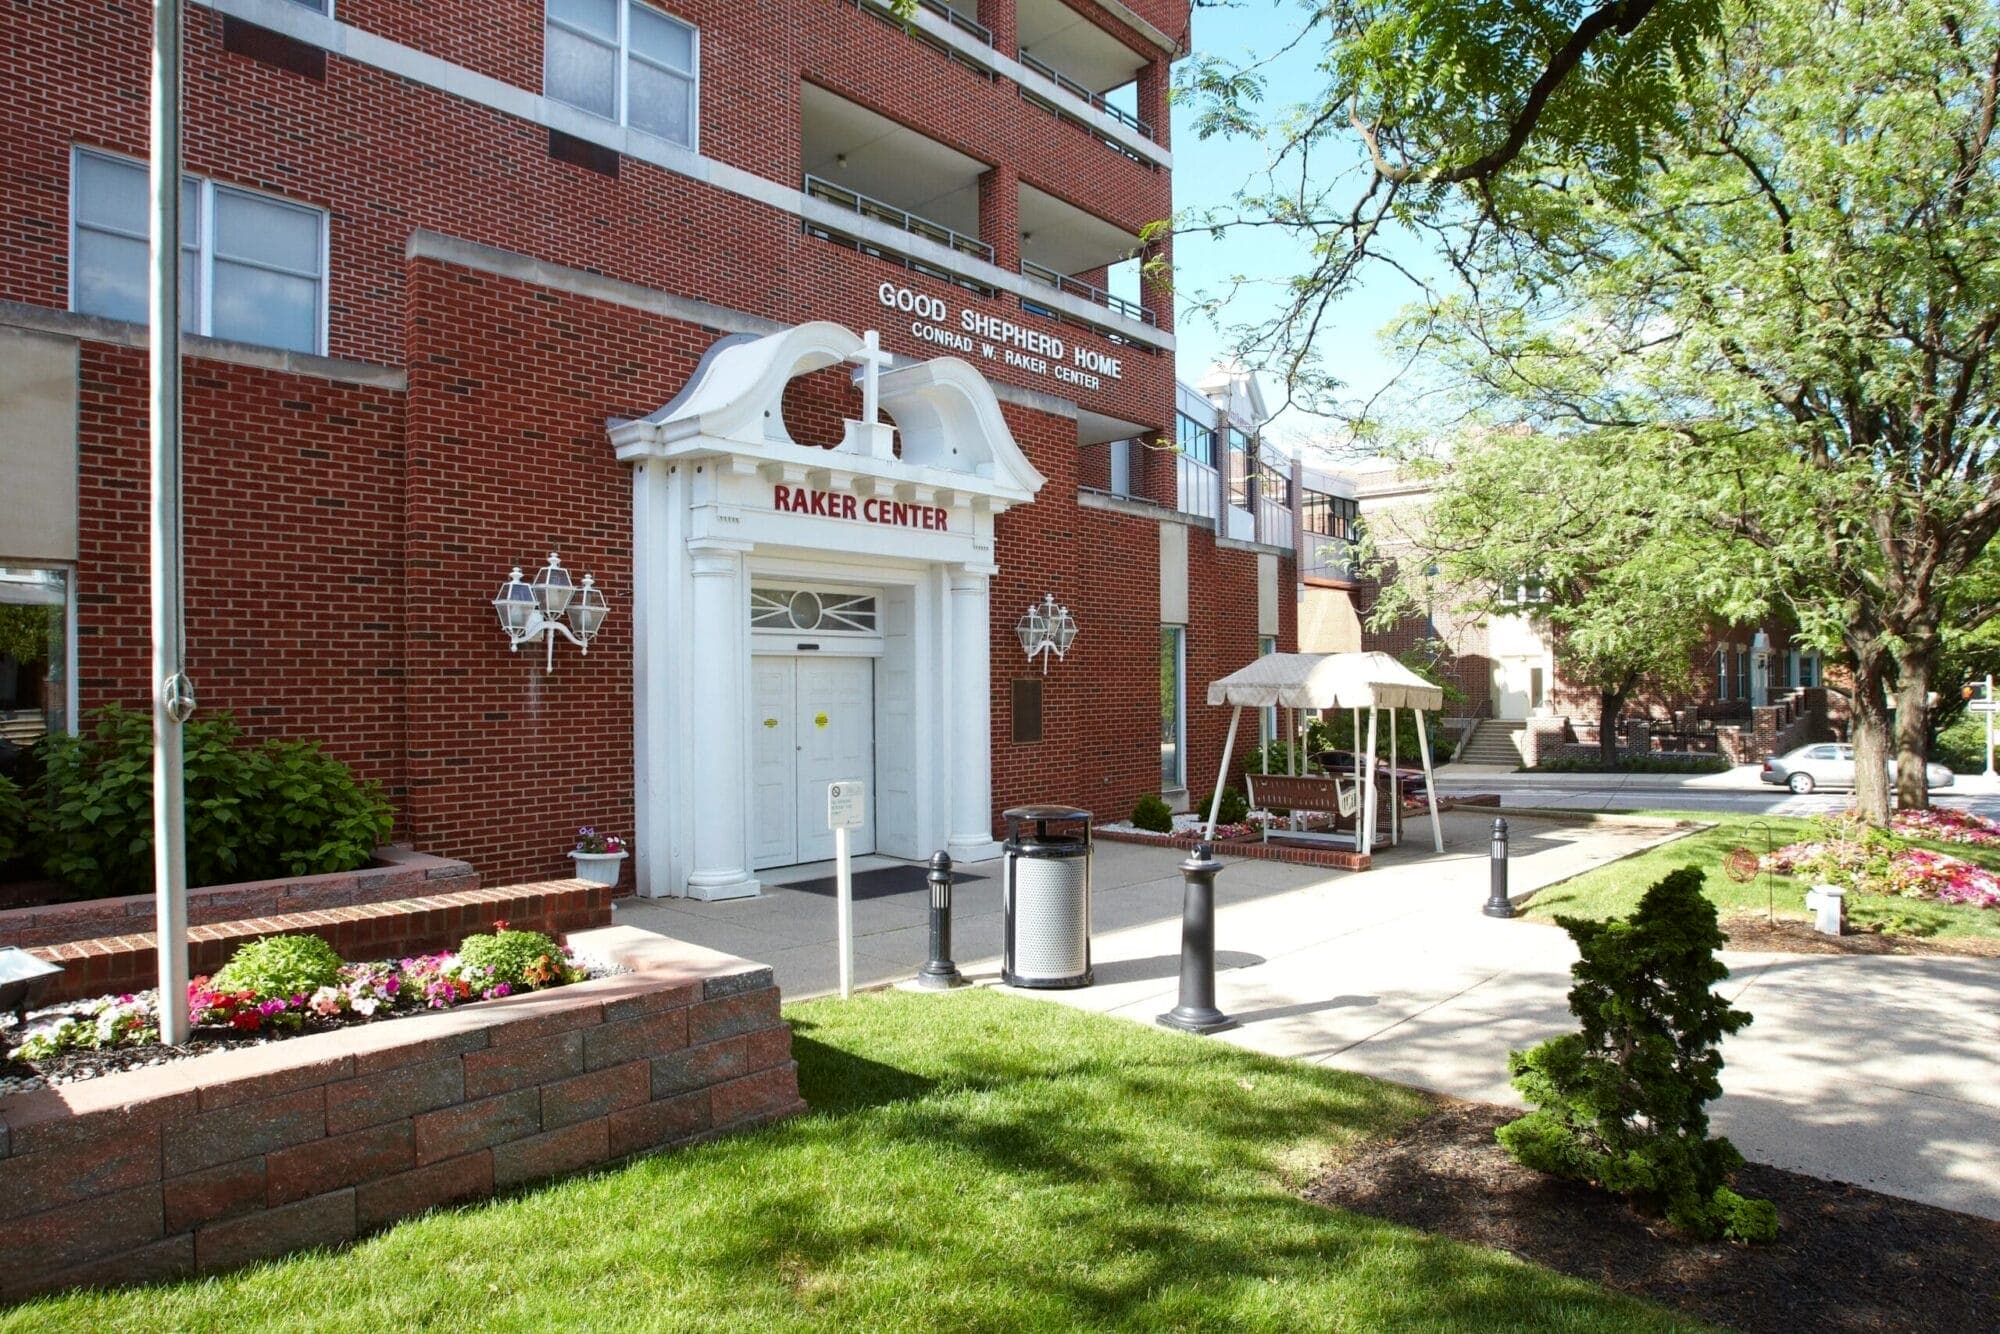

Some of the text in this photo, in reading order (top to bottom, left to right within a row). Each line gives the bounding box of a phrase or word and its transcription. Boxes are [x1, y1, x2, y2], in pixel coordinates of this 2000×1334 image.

[879, 282, 1123, 379] GOOD SHEPHERD HOME
[912, 321, 1100, 391] CONRAD W. RAKER CENTER
[774, 485, 948, 531] RAKER CENTER
